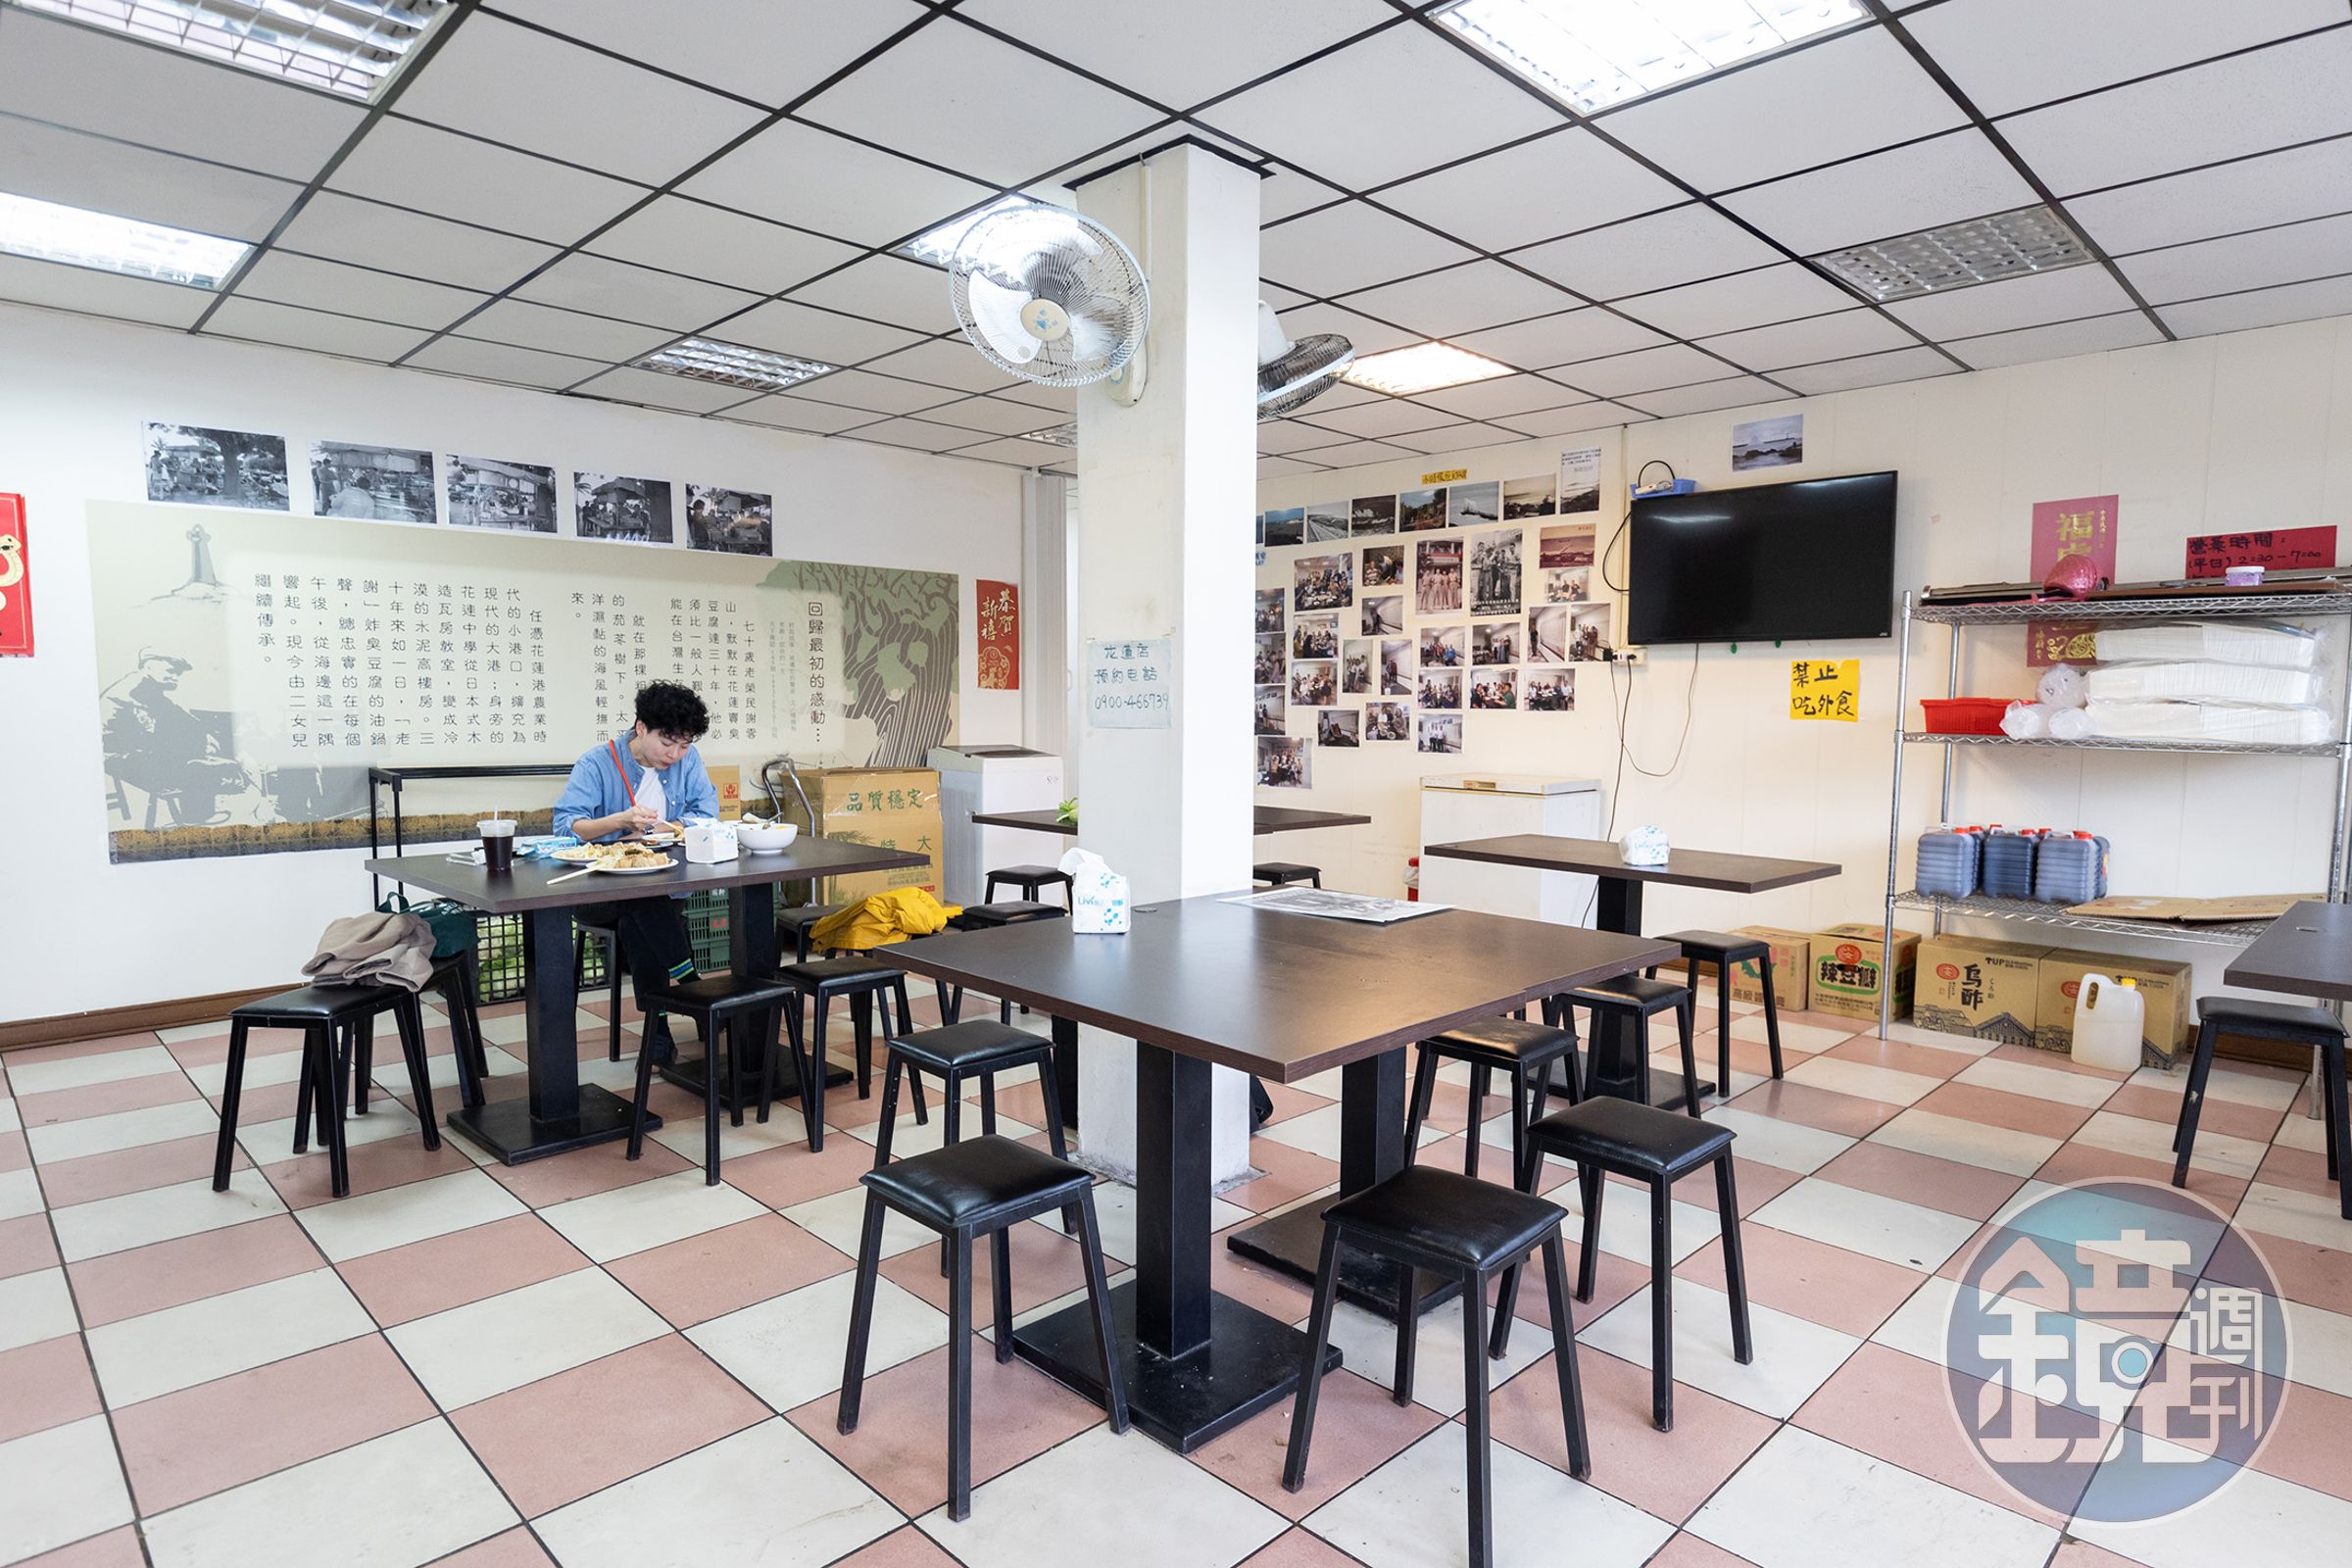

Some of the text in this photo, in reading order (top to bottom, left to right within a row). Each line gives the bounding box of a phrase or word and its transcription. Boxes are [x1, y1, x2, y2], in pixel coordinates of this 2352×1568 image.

[1792, 662, 1838, 688] 禁止
[1792, 690, 1855, 716] 吃外食
[847, 788, 923, 812] 品質穩定
